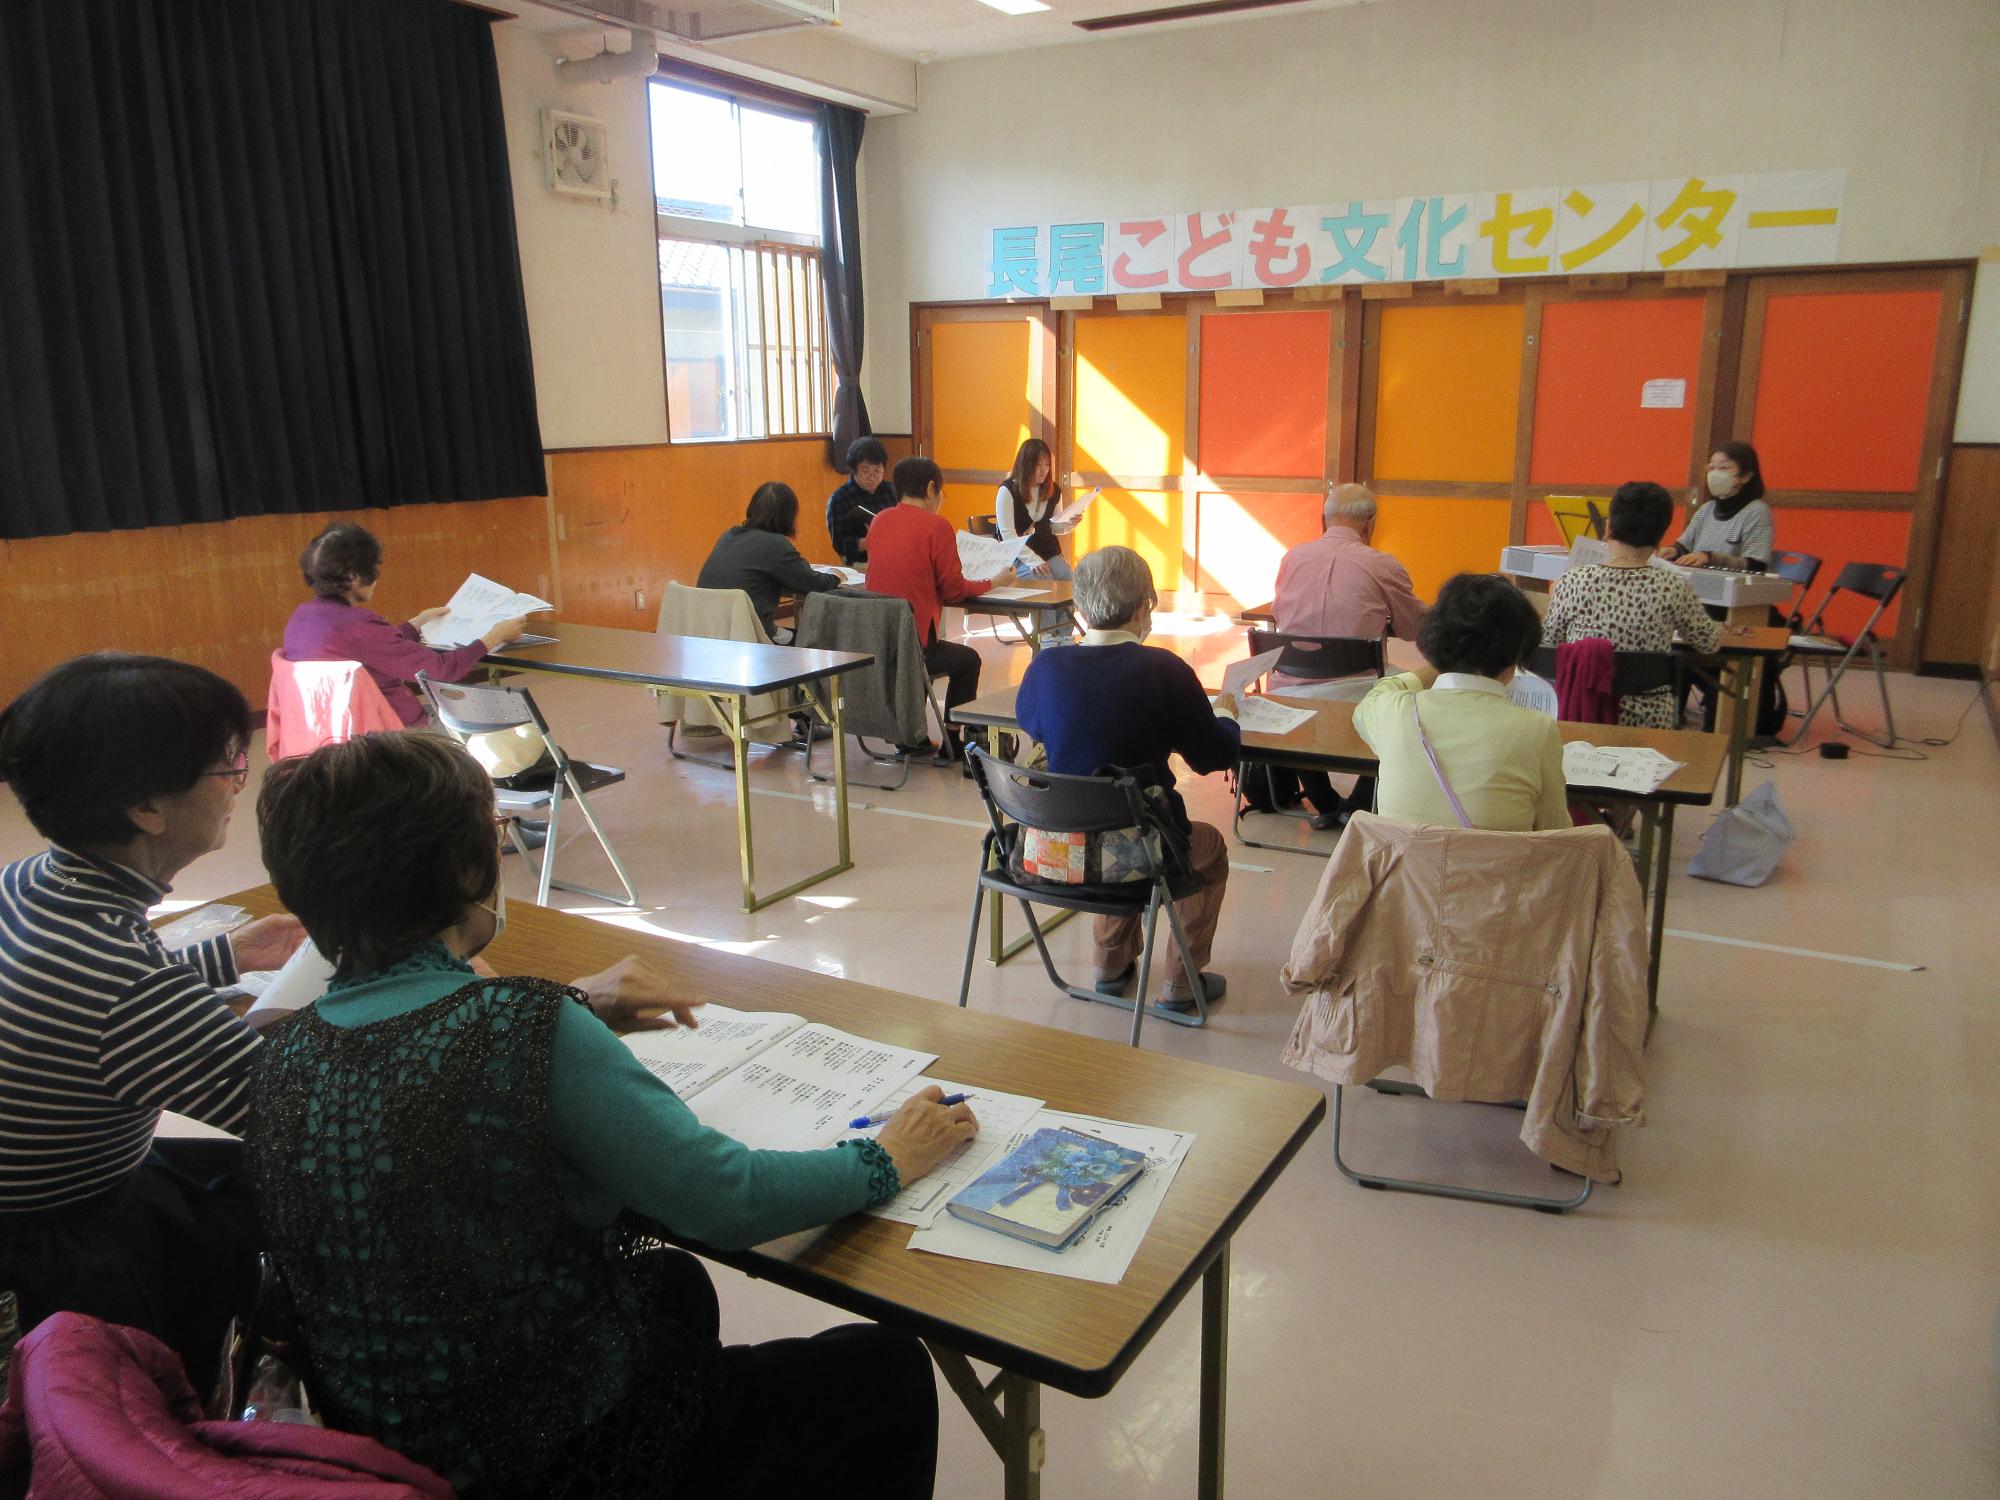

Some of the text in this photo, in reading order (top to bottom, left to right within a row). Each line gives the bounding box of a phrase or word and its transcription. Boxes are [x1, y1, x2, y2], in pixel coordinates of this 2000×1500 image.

[989, 177, 1838, 297] 長尾こども文化センター
